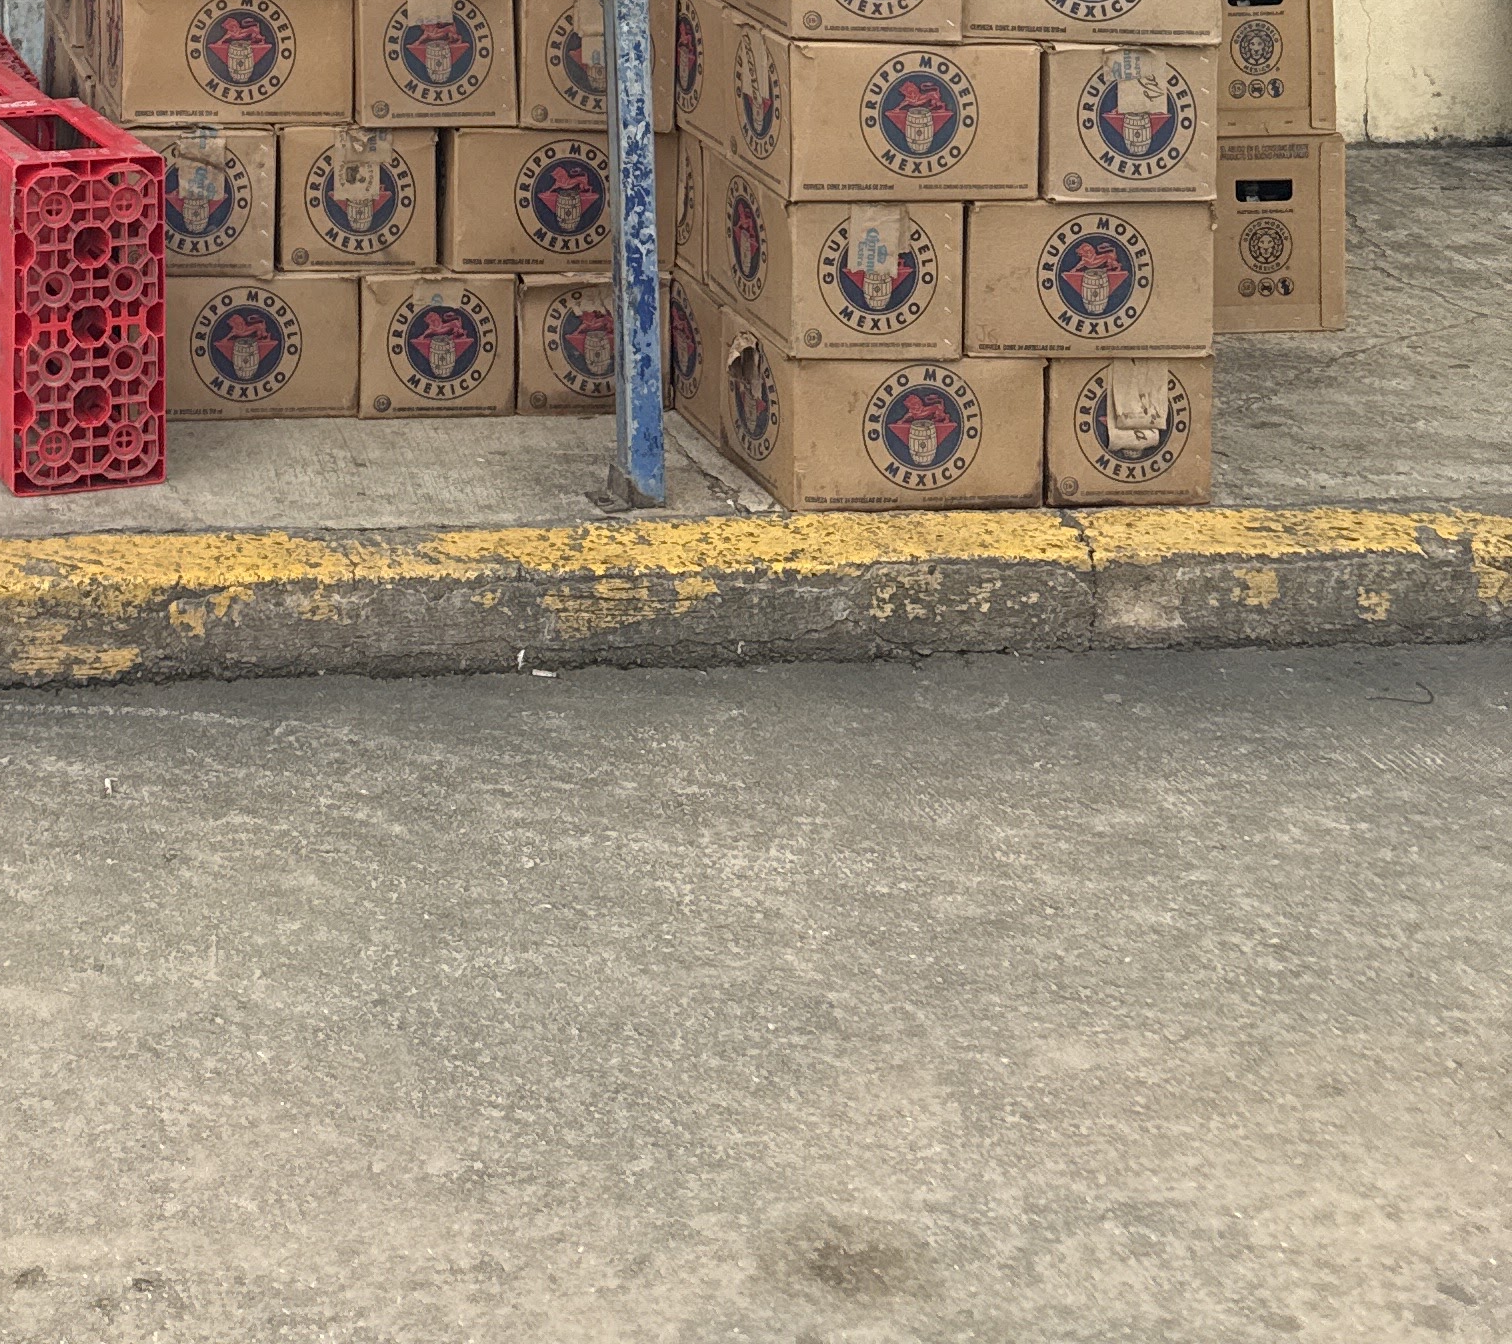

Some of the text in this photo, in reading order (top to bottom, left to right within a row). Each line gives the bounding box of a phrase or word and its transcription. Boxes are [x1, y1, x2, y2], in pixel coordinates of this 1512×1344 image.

[190, 0, 228, 60] GRUPO
[1255, 22, 1279, 44] MODELO
[205, 75, 280, 101] MEXICO
[404, 75, 479, 102] MEXICO
[865, 55, 974, 128] GRUPO MODELO
[881, 145, 961, 174] MEXICO
[1099, 147, 1180, 176] MEXICO
[1264, 220, 1288, 241] MODELO
[1042, 216, 1150, 290] GRUPO MODELO
[194, 290, 298, 357] GRUPO MODELO
[392, 293, 494, 355] GRUP ODELO
[838, 302, 920, 331] MEXICO
[1057, 306, 1137, 335] MEXICO
[209, 372, 286, 399] MEXICO
[406, 369, 482, 396] MEXICO
[868, 368, 979, 442] GRUPO MODELO
[884, 457, 965, 487] MEXICO
